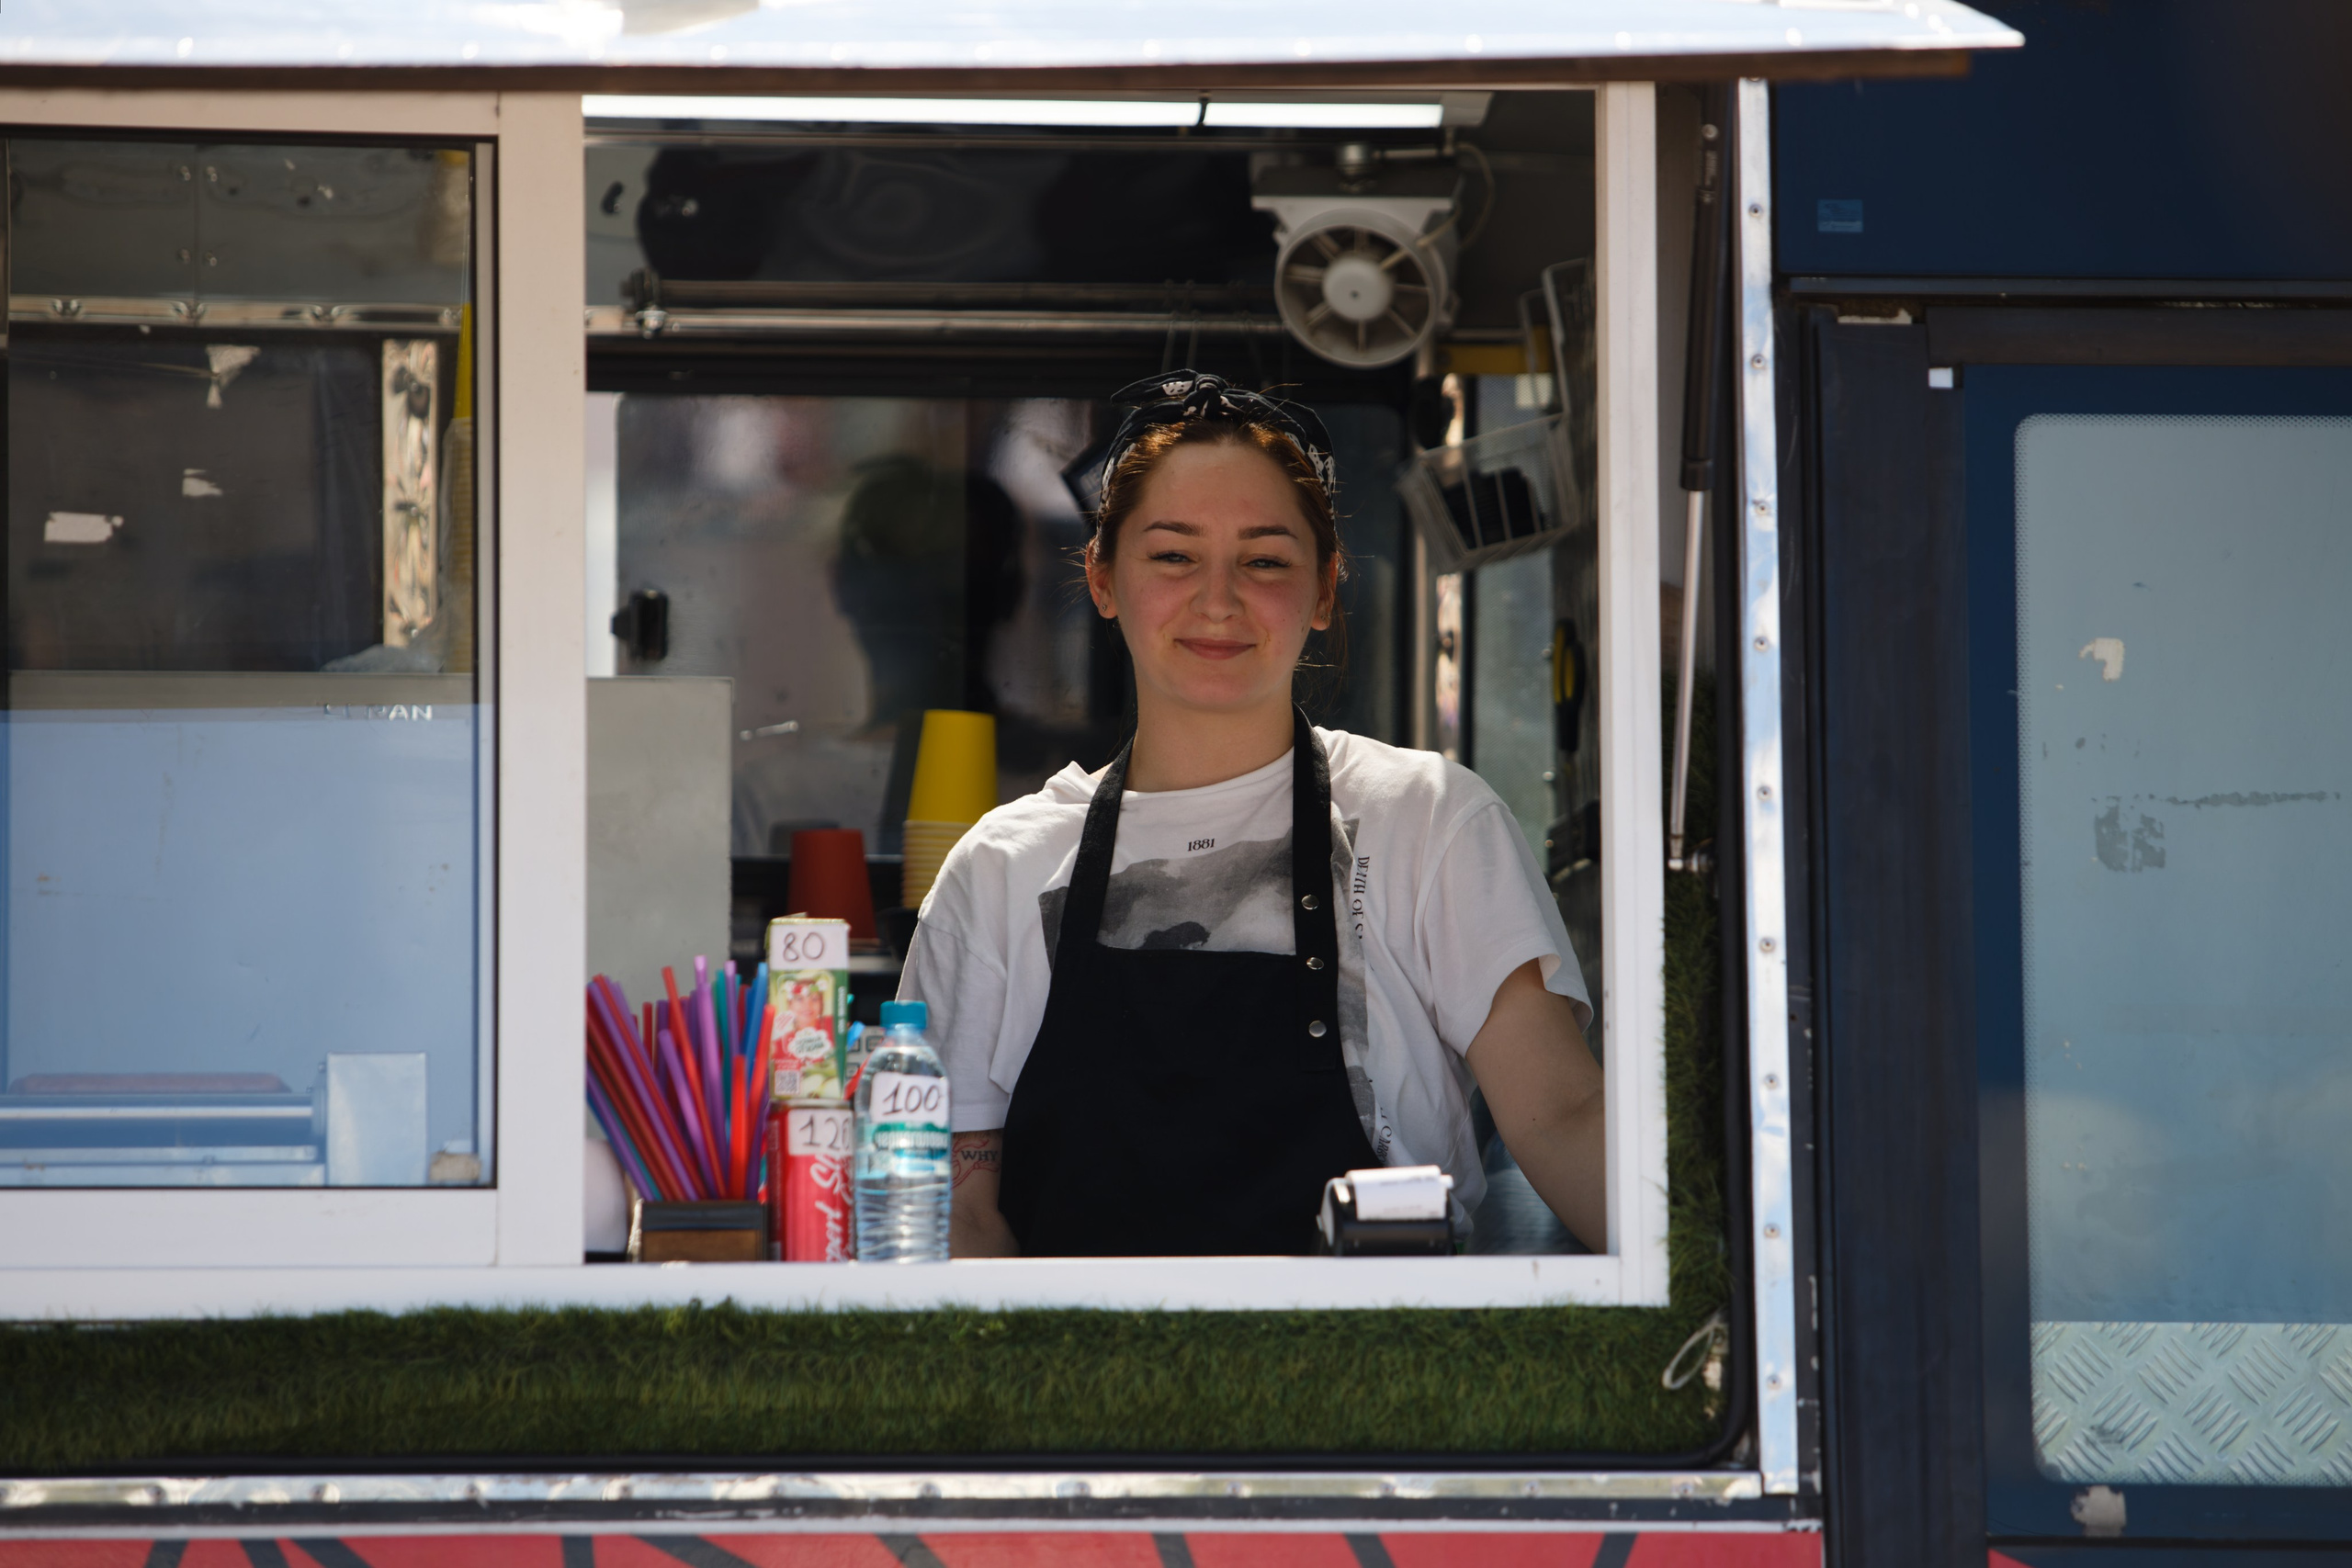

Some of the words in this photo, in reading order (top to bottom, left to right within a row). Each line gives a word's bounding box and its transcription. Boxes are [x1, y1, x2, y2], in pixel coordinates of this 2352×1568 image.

[1188, 838, 1215, 852] 1881
[1353, 856, 1370, 894] DEATH
[1351, 898, 1363, 919] OF
[783, 931, 824, 962] 80
[882, 1081, 941, 1116] 100
[961, 1150, 998, 1162] WHY
